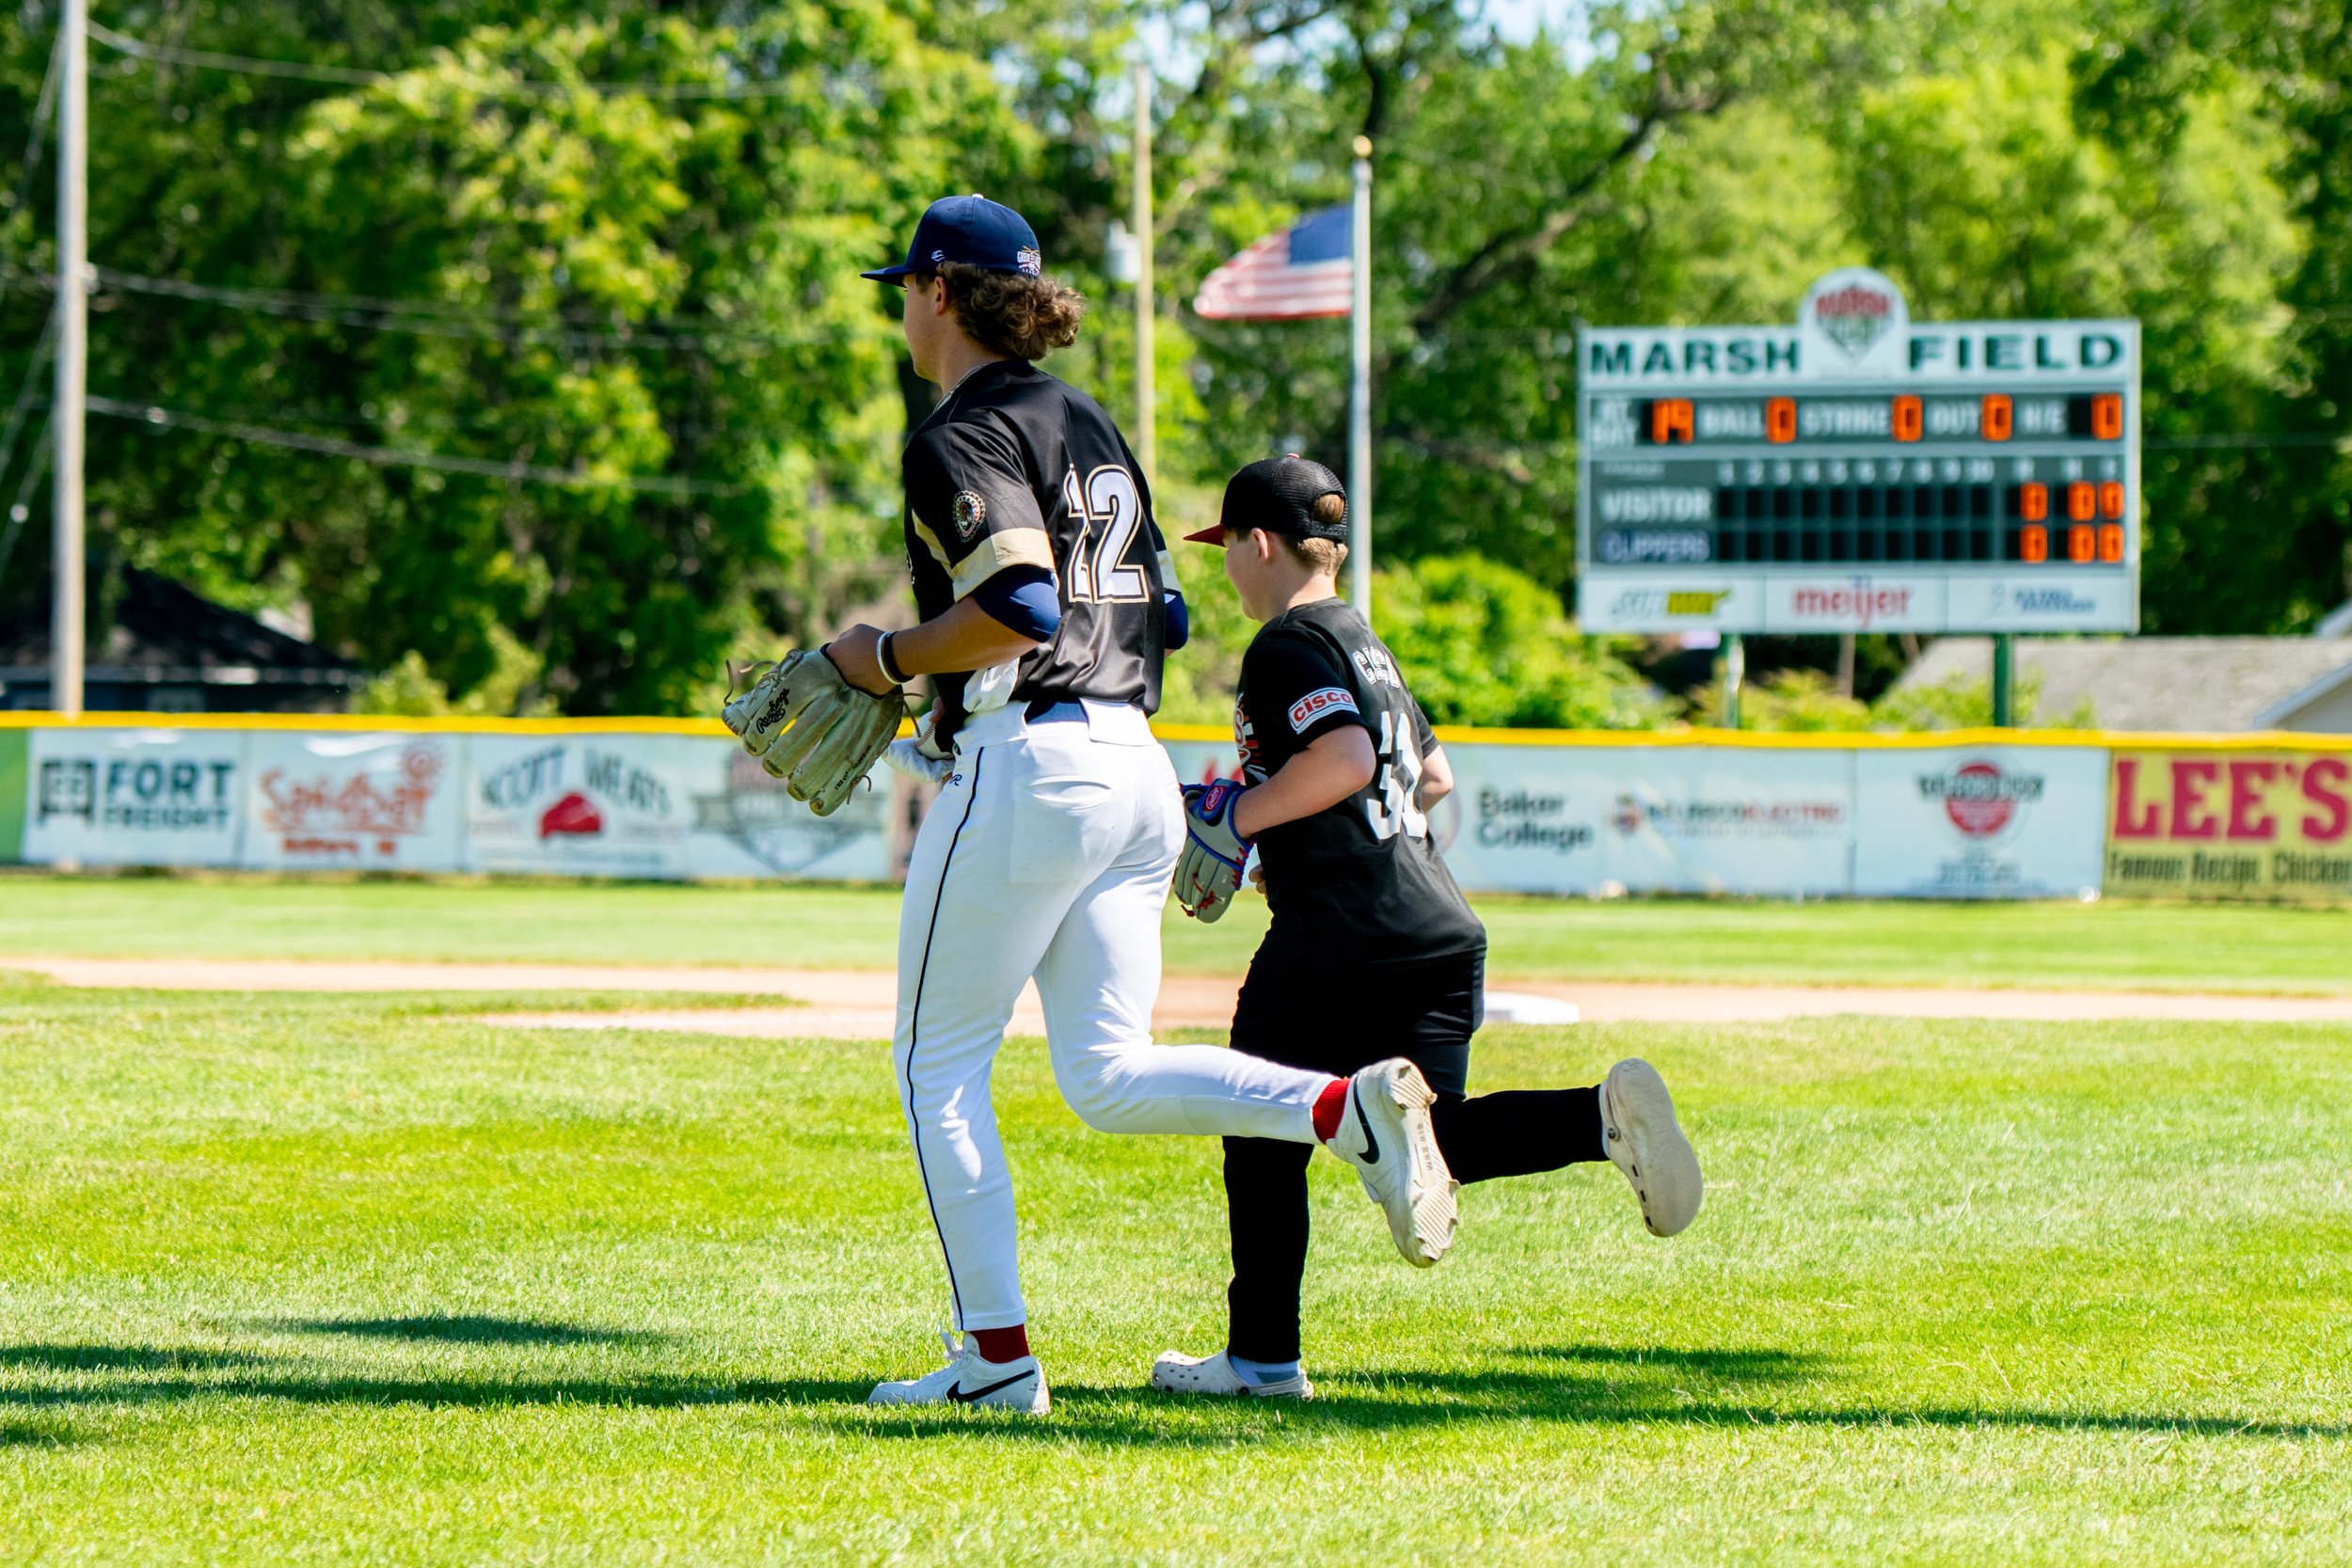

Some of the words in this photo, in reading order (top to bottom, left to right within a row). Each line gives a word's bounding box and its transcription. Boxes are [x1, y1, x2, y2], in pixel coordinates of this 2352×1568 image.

[1590, 338, 1801, 373] MARSH
[1908, 333, 2123, 372] FIELD
[1698, 404, 1764, 437] BALL
[1766, 396, 1797, 445] 0
[1803, 404, 1891, 437] STRIKE
[1891, 393, 1923, 443] 0
[1932, 401, 1981, 436] OUT
[1980, 392, 2013, 441] 0
[2090, 391, 2123, 441] 0
[1603, 487, 1711, 522] VISITOR
[2020, 481, 2048, 522] 0
[2068, 480, 2095, 522] 0
[1599, 530, 1710, 562] CLIPPERS
[2020, 524, 2048, 564] 0
[2068, 523, 2095, 564] 0
[1793, 576, 1913, 629] meijer
[756, 689, 789, 734] Rawlings
[1293, 690, 1353, 723] cisco
[105, 758, 235, 800] FORT
[2114, 758, 2351, 840] LEE'S
[103, 806, 232, 831] FREIGHT
[1479, 785, 1565, 818] Baker
[1476, 820, 1594, 854] College
[2109, 852, 2185, 881] Famous
[2192, 849, 2260, 891] Recipe
